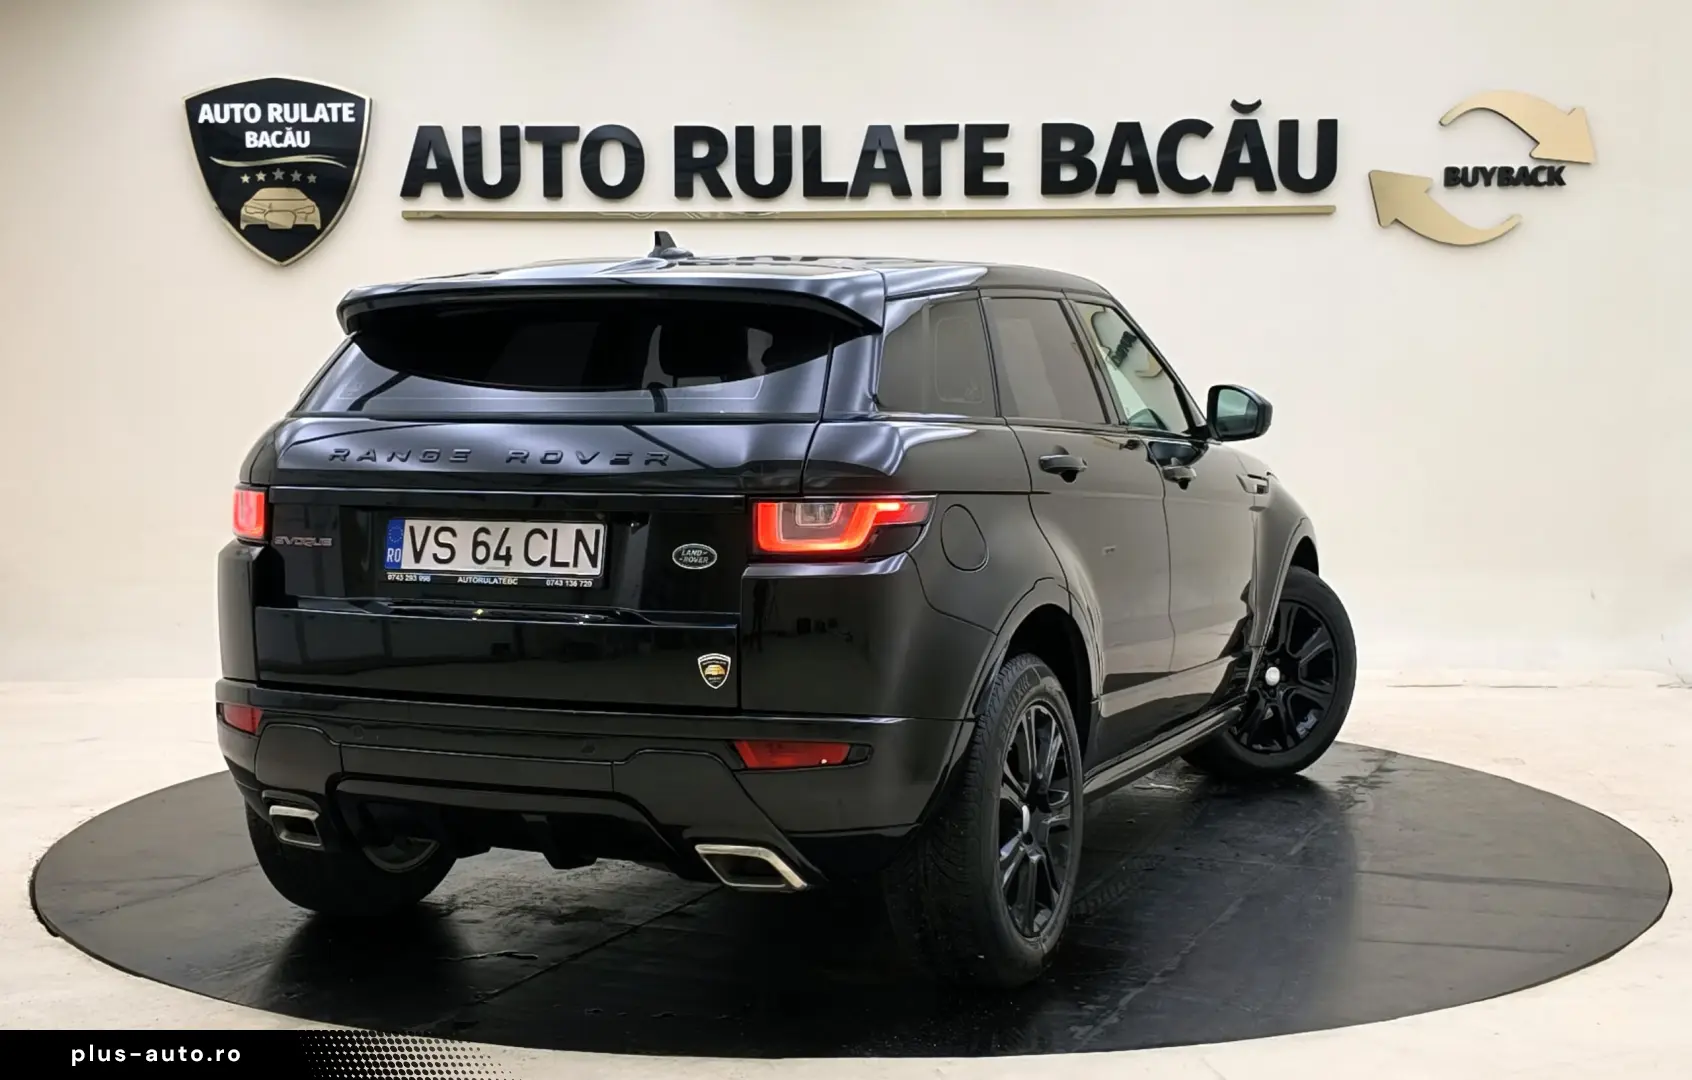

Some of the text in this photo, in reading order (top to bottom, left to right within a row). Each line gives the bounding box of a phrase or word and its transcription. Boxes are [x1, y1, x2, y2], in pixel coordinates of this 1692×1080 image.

[198, 102, 356, 124] AUTO RULATE
[245, 127, 310, 148] BACĂU
[400, 98, 1338, 200] AUTO RULATE BACĂU
[1443, 165, 1566, 188] BUYBACK
[328, 448, 671, 467] RANGE ROVER
[274, 535, 333, 547] EVOQUE
[409, 525, 600, 568] VS 64 CLN
[386, 547, 401, 563] RO
